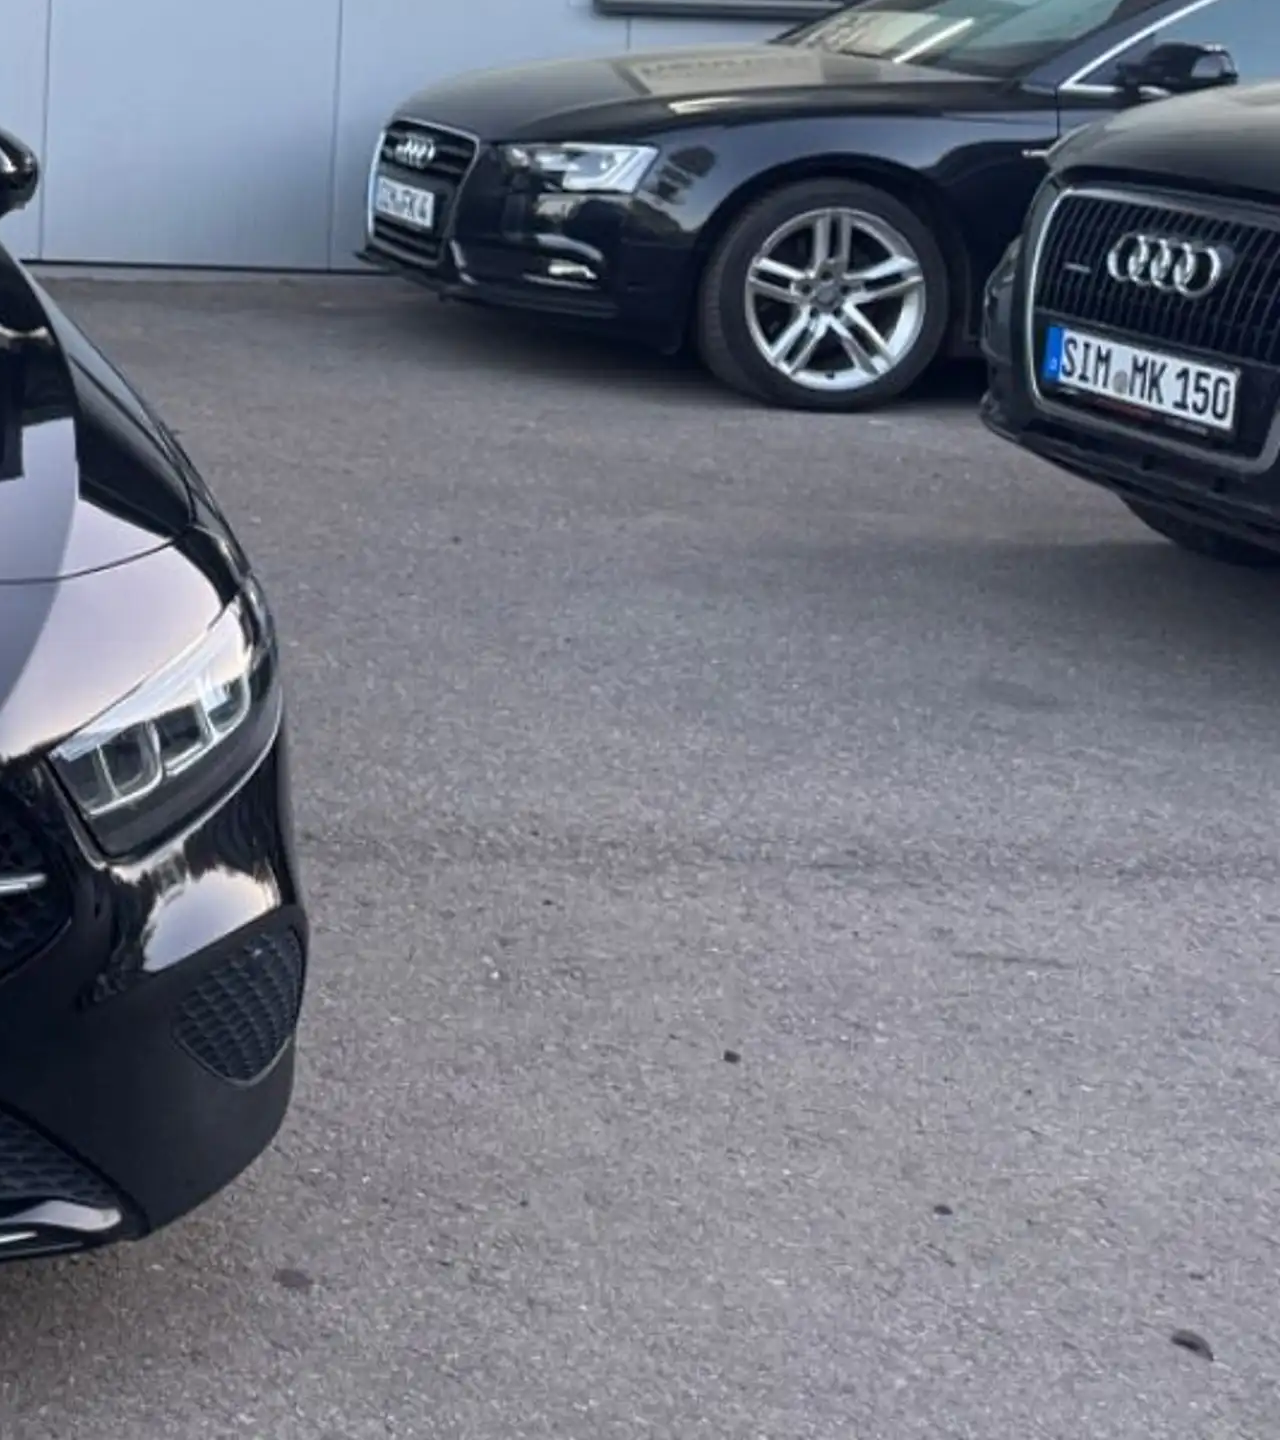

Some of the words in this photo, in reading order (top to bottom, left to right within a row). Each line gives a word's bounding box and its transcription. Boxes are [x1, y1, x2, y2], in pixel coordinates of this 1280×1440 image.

[1061, 337, 1113, 390] SIM
[1128, 355, 1169, 405] MK
[1172, 366, 1231, 420] 150
